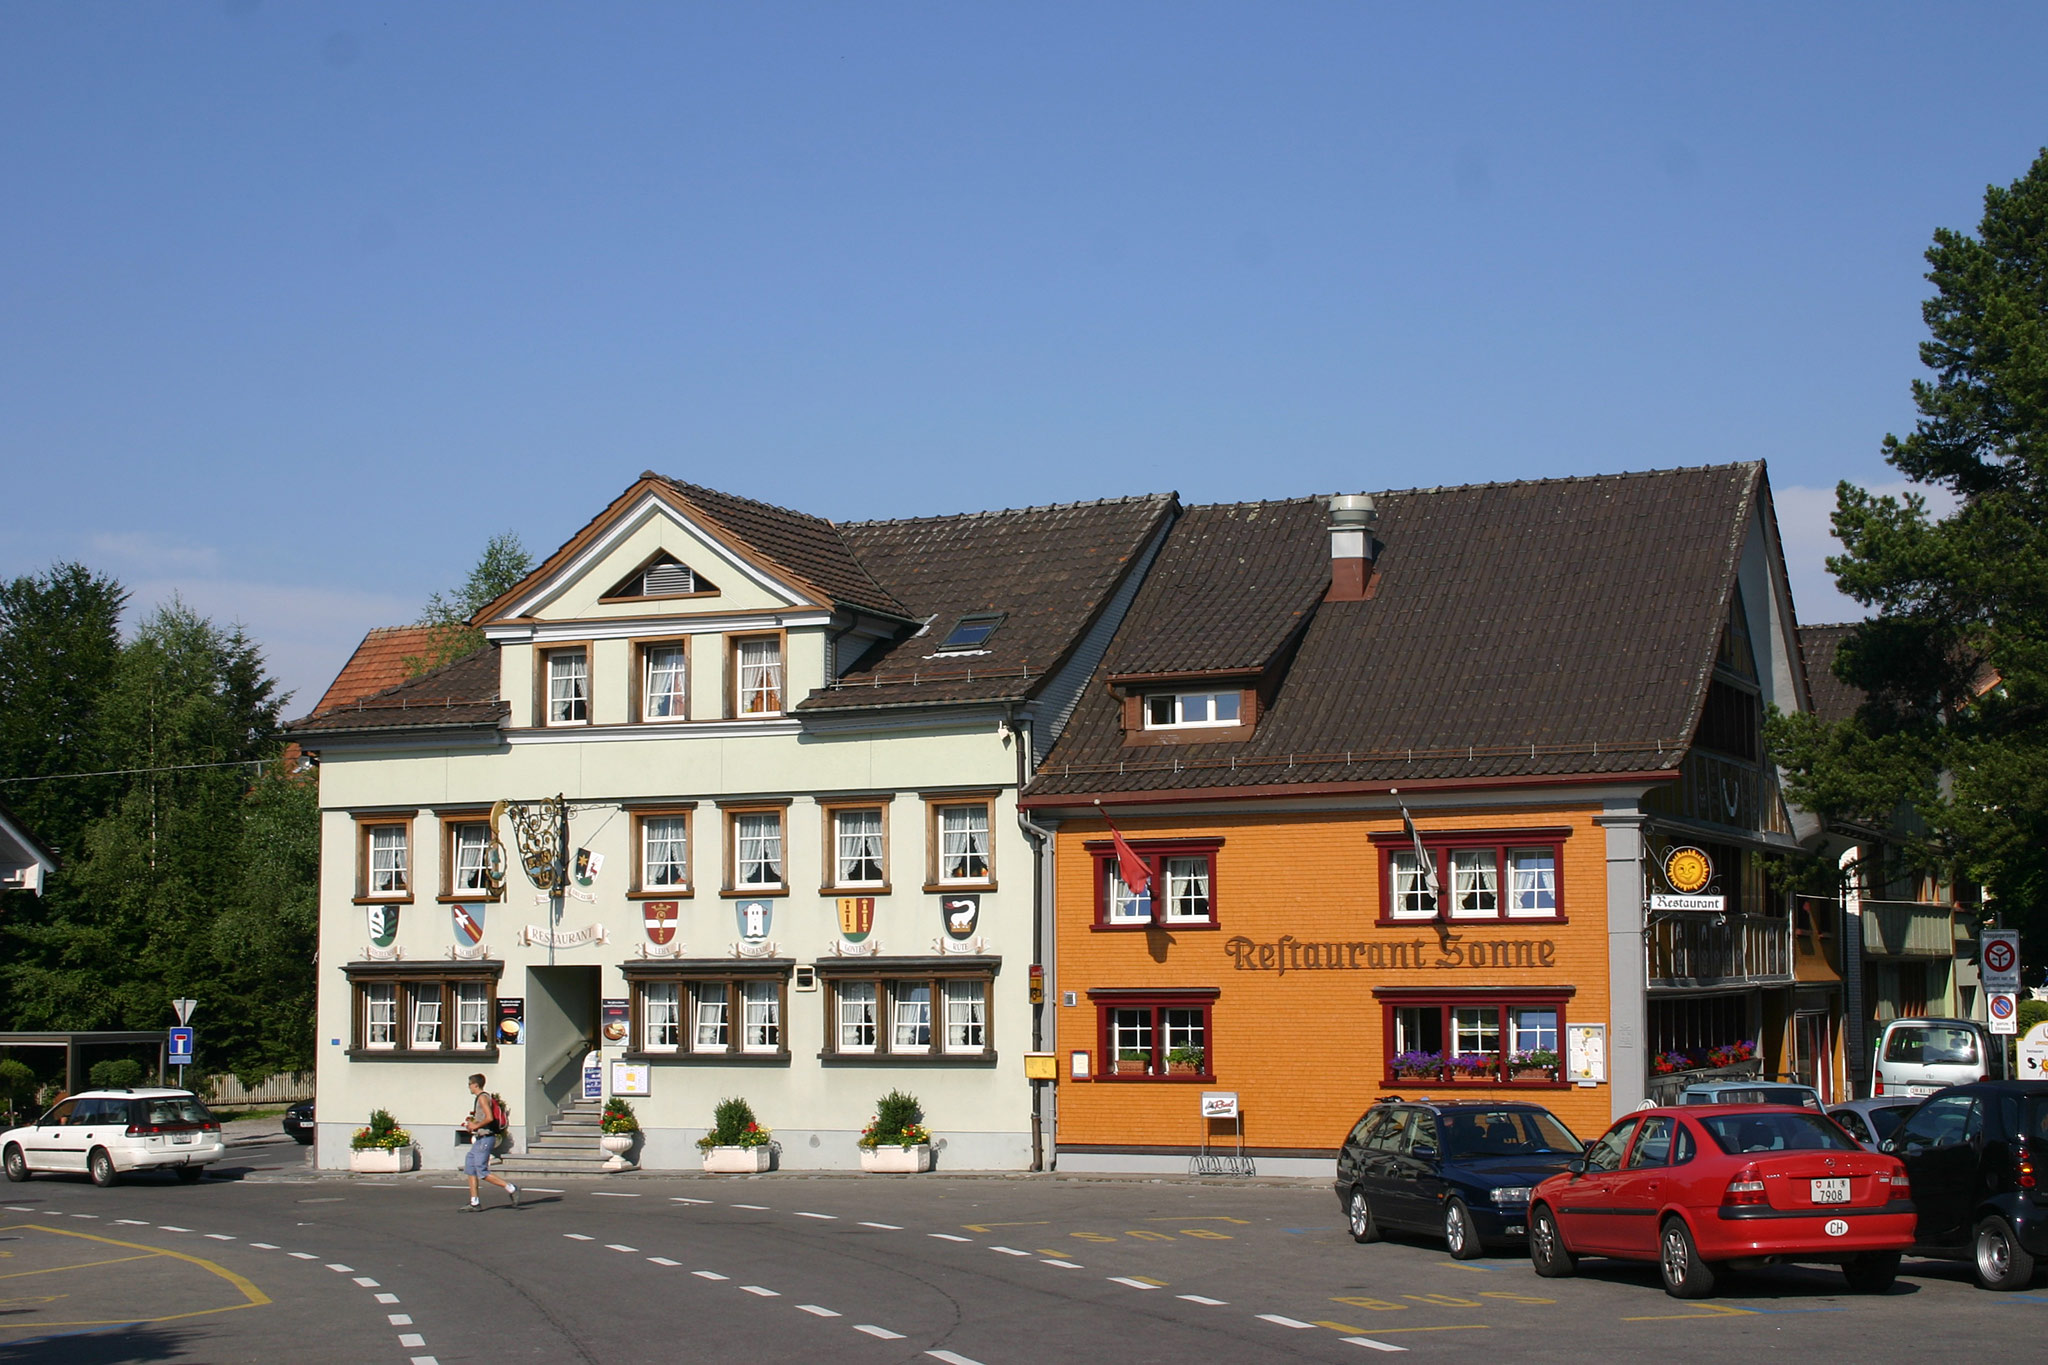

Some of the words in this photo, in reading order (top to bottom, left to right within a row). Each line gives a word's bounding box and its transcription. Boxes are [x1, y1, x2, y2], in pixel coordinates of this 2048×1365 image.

[1656, 895, 1720, 909] Restaurant
[532, 927, 592, 945] RESTAURANT
[1435, 934, 1556, 968] Sonne
[1826, 1180, 1835, 1189] AI
[1820, 1190, 1843, 1201] 7908
[1830, 1222, 1843, 1234] CH
